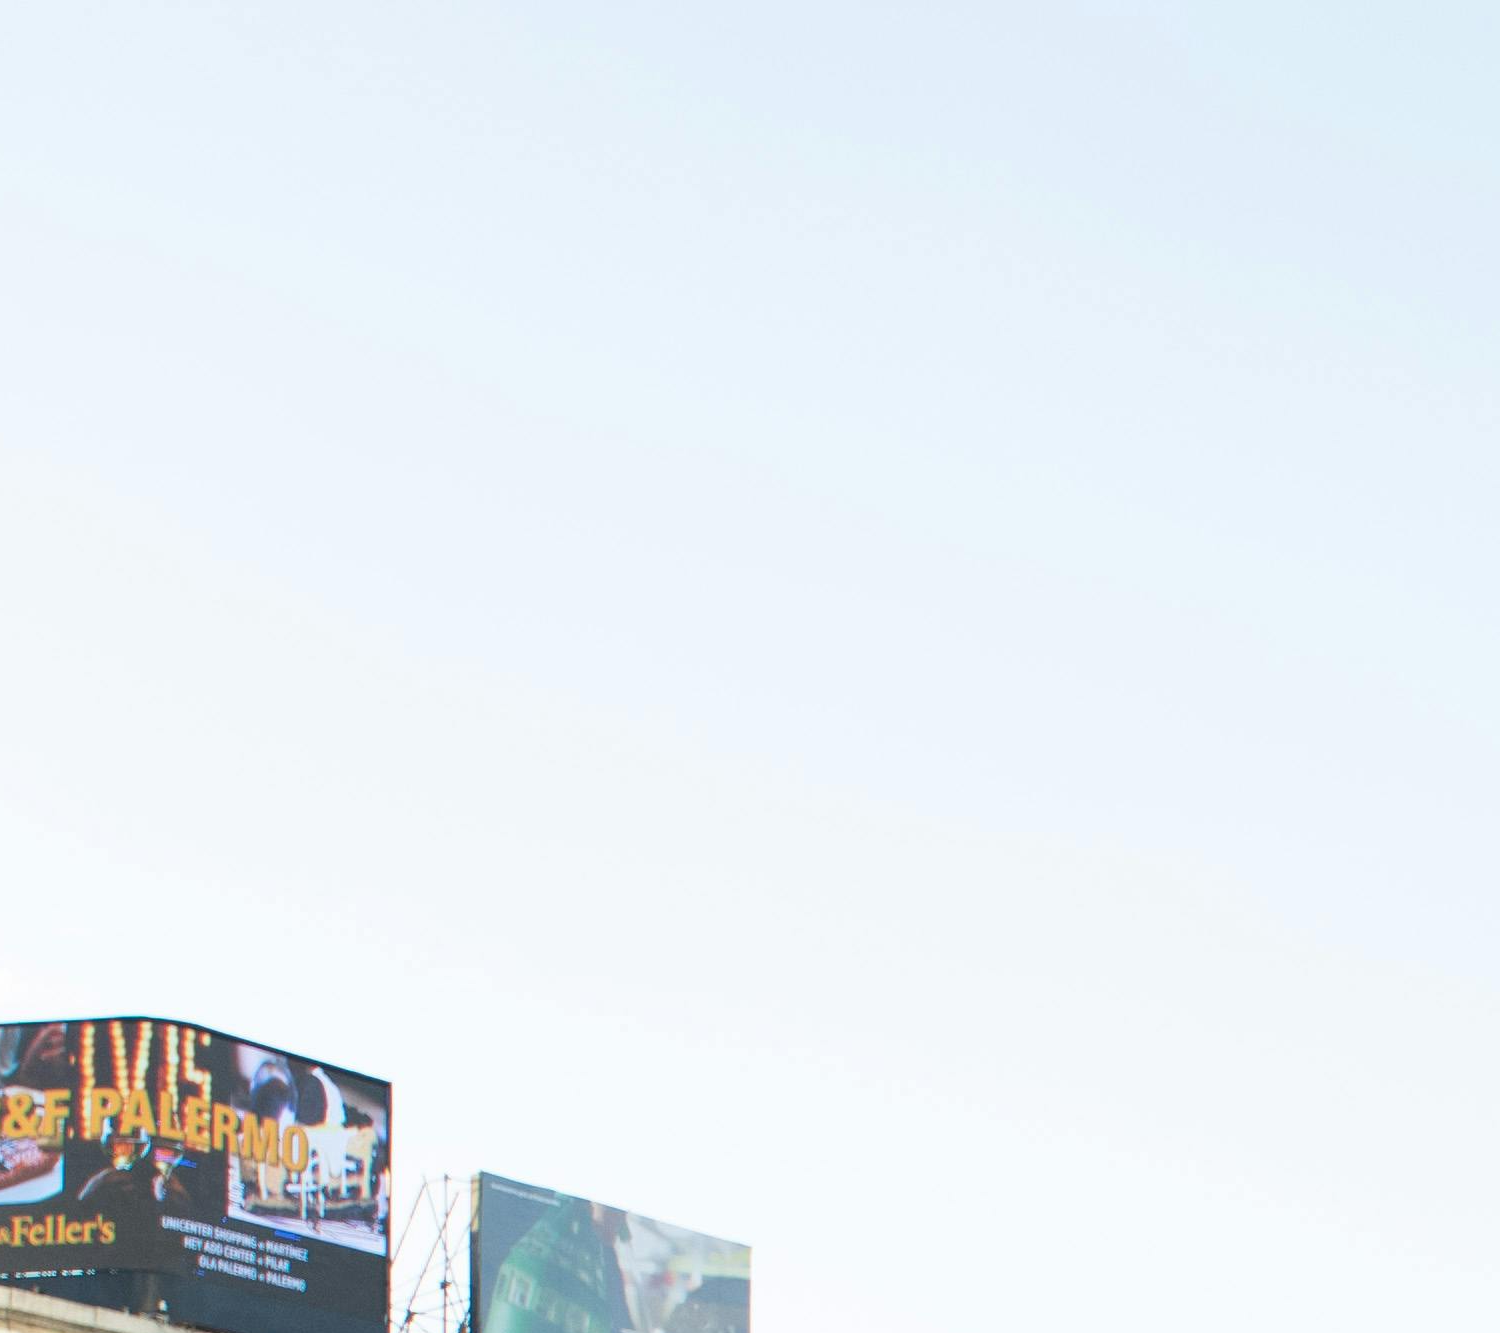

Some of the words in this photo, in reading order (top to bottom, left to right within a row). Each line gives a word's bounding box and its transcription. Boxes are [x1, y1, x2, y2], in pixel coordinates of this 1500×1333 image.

[91, 1087, 309, 1172] PALERMO
[160, 1215, 213, 1238] UNICENTER
[214, 1226, 257, 1249] SHOPPING
